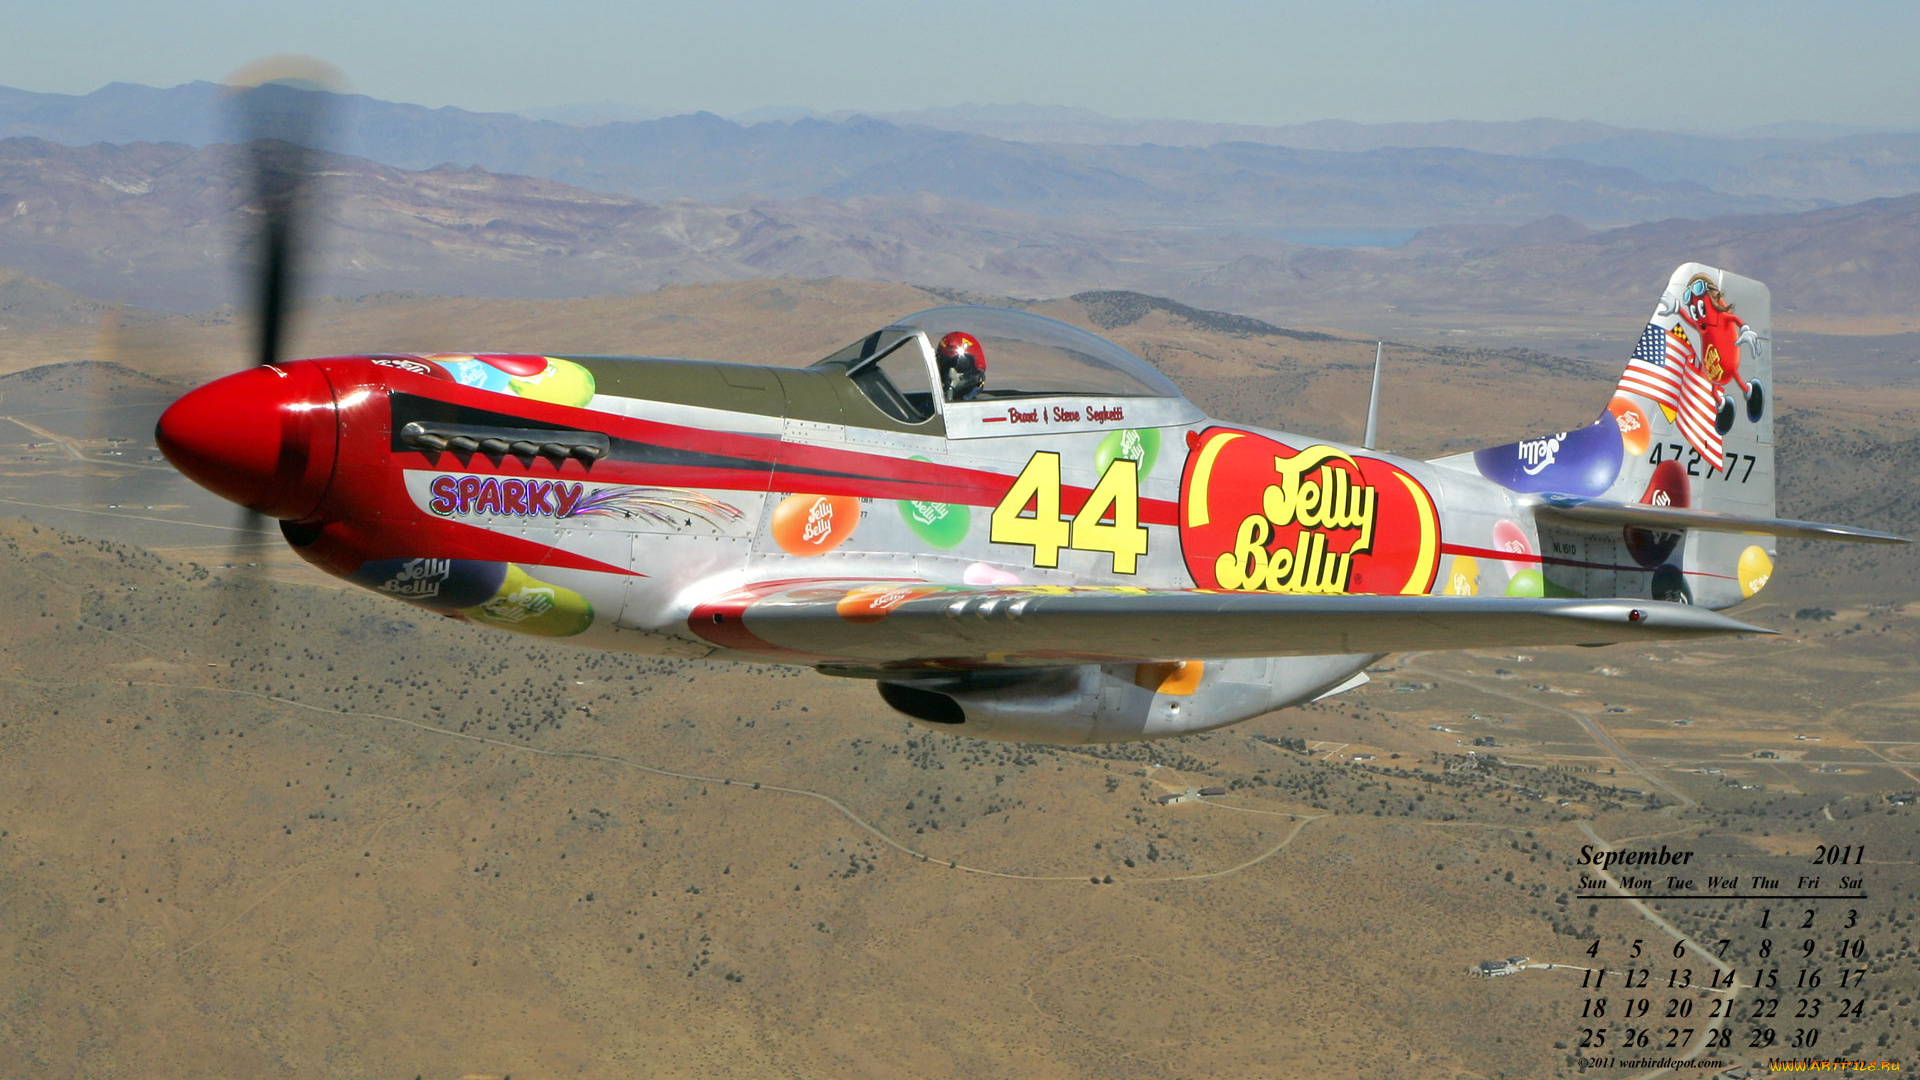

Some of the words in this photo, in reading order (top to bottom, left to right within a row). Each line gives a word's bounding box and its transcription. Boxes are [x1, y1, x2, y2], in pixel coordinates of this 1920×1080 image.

[1053, 406, 1081, 423] Steve
[1086, 405, 1125, 425] Seghetti
[1518, 438, 1561, 476] Jelly
[430, 475, 584, 520] SPARKY
[808, 496, 834, 523] Jelly
[989, 450, 1150, 576] 44
[1263, 444, 1379, 555] Jelly
[803, 518, 832, 545] Belly
[1214, 513, 1351, 593] Belly
[395, 557, 451, 582] Jelly
[378, 579, 440, 599] Belly
[506, 586, 556, 618] Jelly
